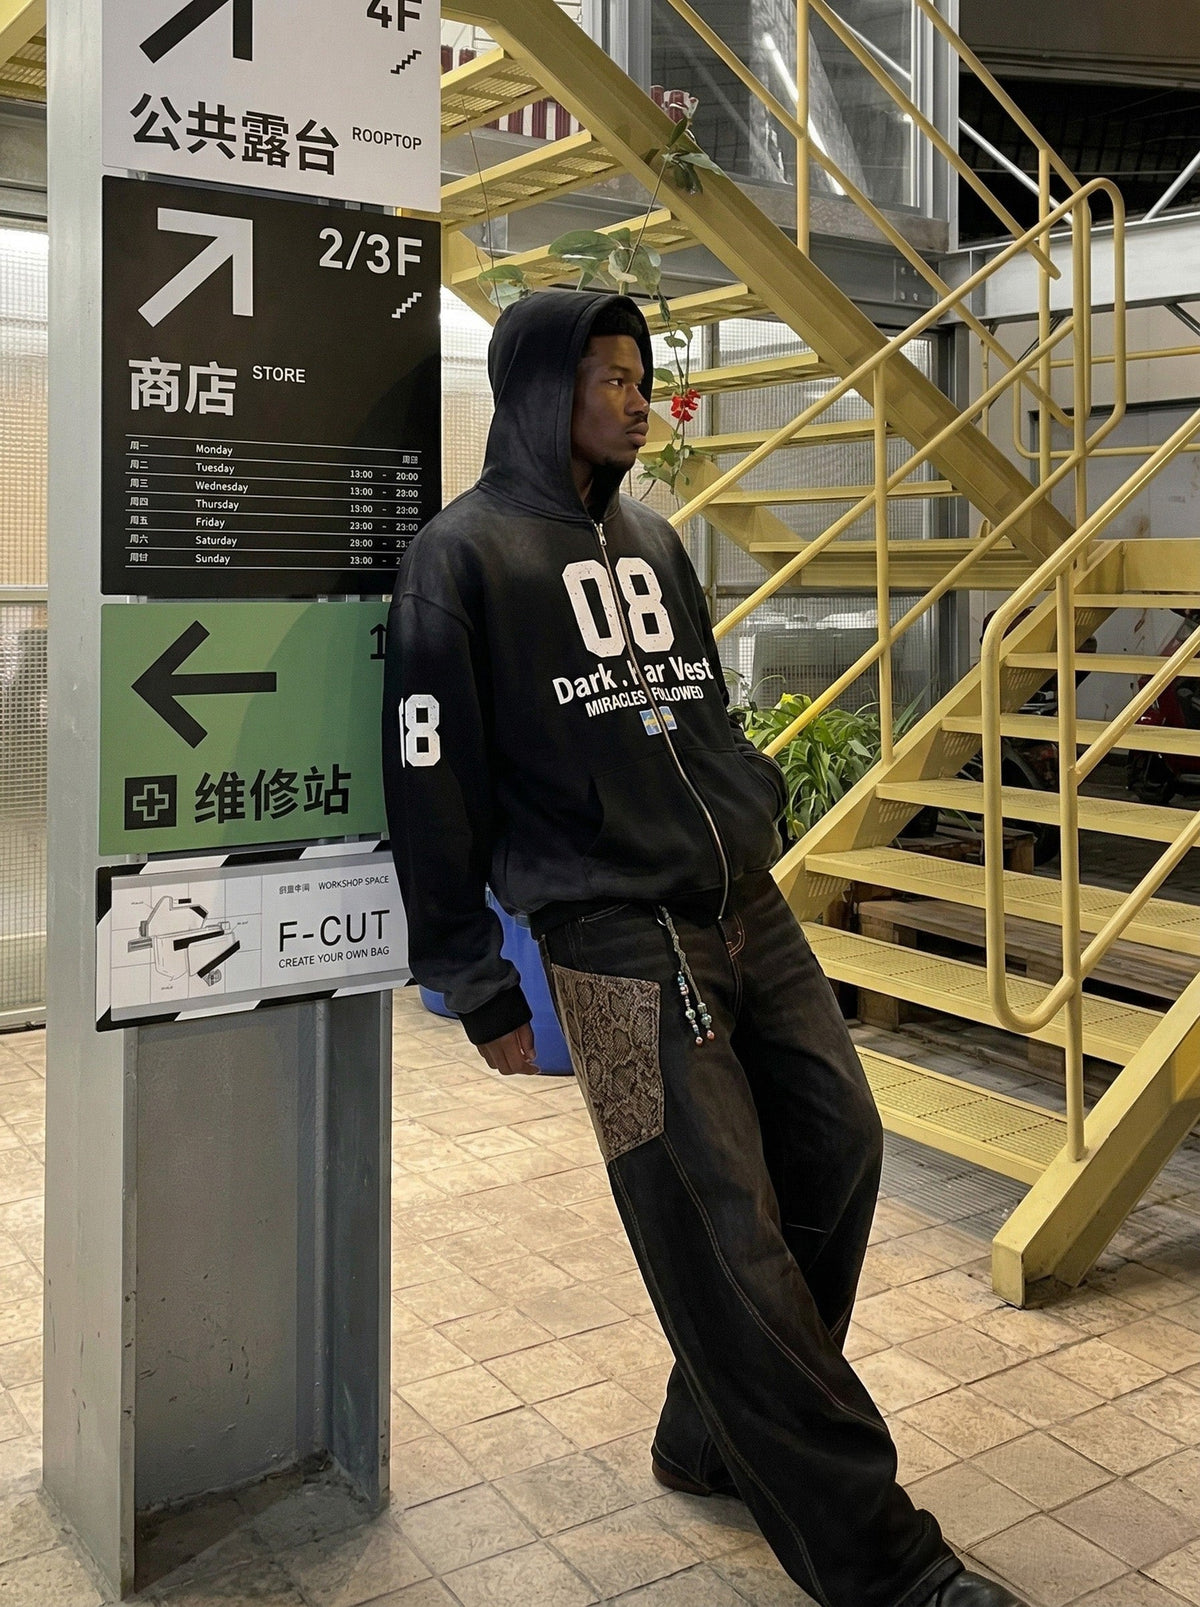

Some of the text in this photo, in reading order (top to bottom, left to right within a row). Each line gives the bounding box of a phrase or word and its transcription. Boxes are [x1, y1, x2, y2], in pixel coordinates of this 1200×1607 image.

[367, 0, 422, 32] 4F
[129, 93, 339, 175] 公共露台
[353, 127, 421, 150] ROOPTOP
[320, 228, 422, 275] 2/3F
[253, 365, 306, 383] STORE
[129, 357, 237, 415] 商店
[195, 444, 233, 457] Monday
[130, 459, 149, 470] 周二
[195, 463, 235, 475] Tuesday
[351, 469, 373, 479] 13:00
[396, 471, 419, 481] 20:00
[130, 477, 149, 488] 周三
[195, 481, 249, 494] Wednesday
[351, 486, 373, 496] 13:00
[195, 499, 240, 512] Thursday
[396, 505, 419, 515] 23:00
[130, 515, 149, 525] 周五
[195, 516, 226, 530] Friday
[350, 521, 373, 531] 23:00
[396, 522, 419, 532] 23:00
[130, 533, 149, 544] 周六
[195, 535, 238, 548] Saturday
[195, 553, 231, 566] Sunday
[562, 557, 674, 658] 08
[552, 663, 618, 705] Dark
[669, 657, 714, 680] Vest
[585, 686, 704, 717] MIRACLES FOLLOWED
[399, 695, 440, 767] 8
[195, 764, 351, 824] 维修站
[319, 879, 364, 891] WORKSHOP
[365, 875, 390, 886] SPACE
[279, 910, 390, 952] F-CUT
[279, 945, 390, 969] CREATE YOUR OWN BAG
